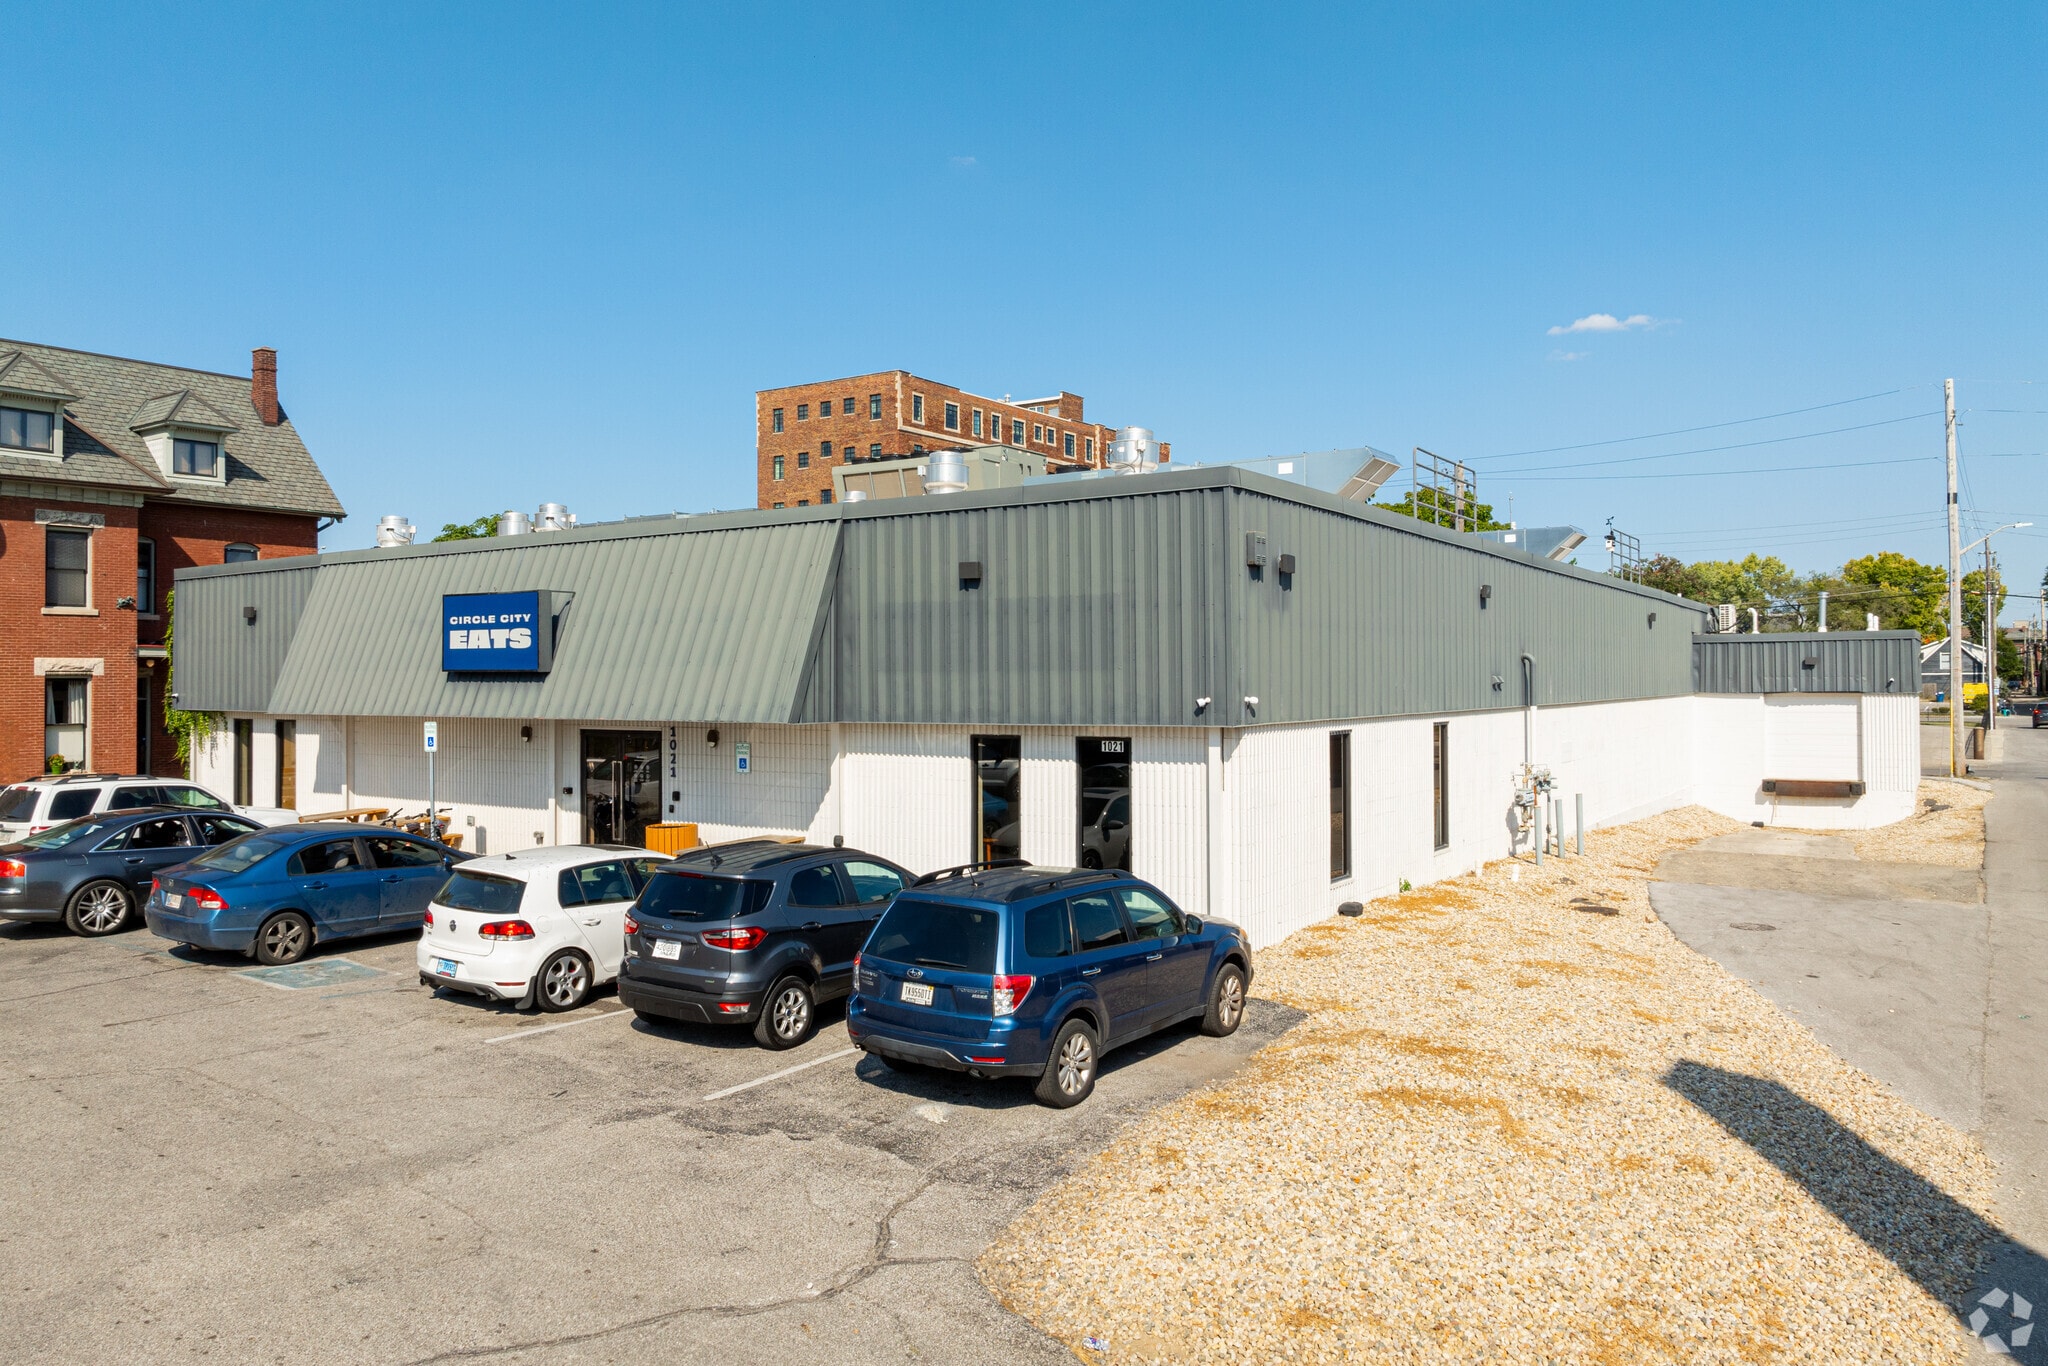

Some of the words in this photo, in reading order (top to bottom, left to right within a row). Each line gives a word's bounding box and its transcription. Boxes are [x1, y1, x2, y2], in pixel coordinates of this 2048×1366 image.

[449, 615, 496, 625] CIRCLE
[500, 613, 531, 623] CITY
[449, 628, 532, 650] EATS
[669, 726, 677, 778] 1021
[1102, 741, 1123, 752] 1021
